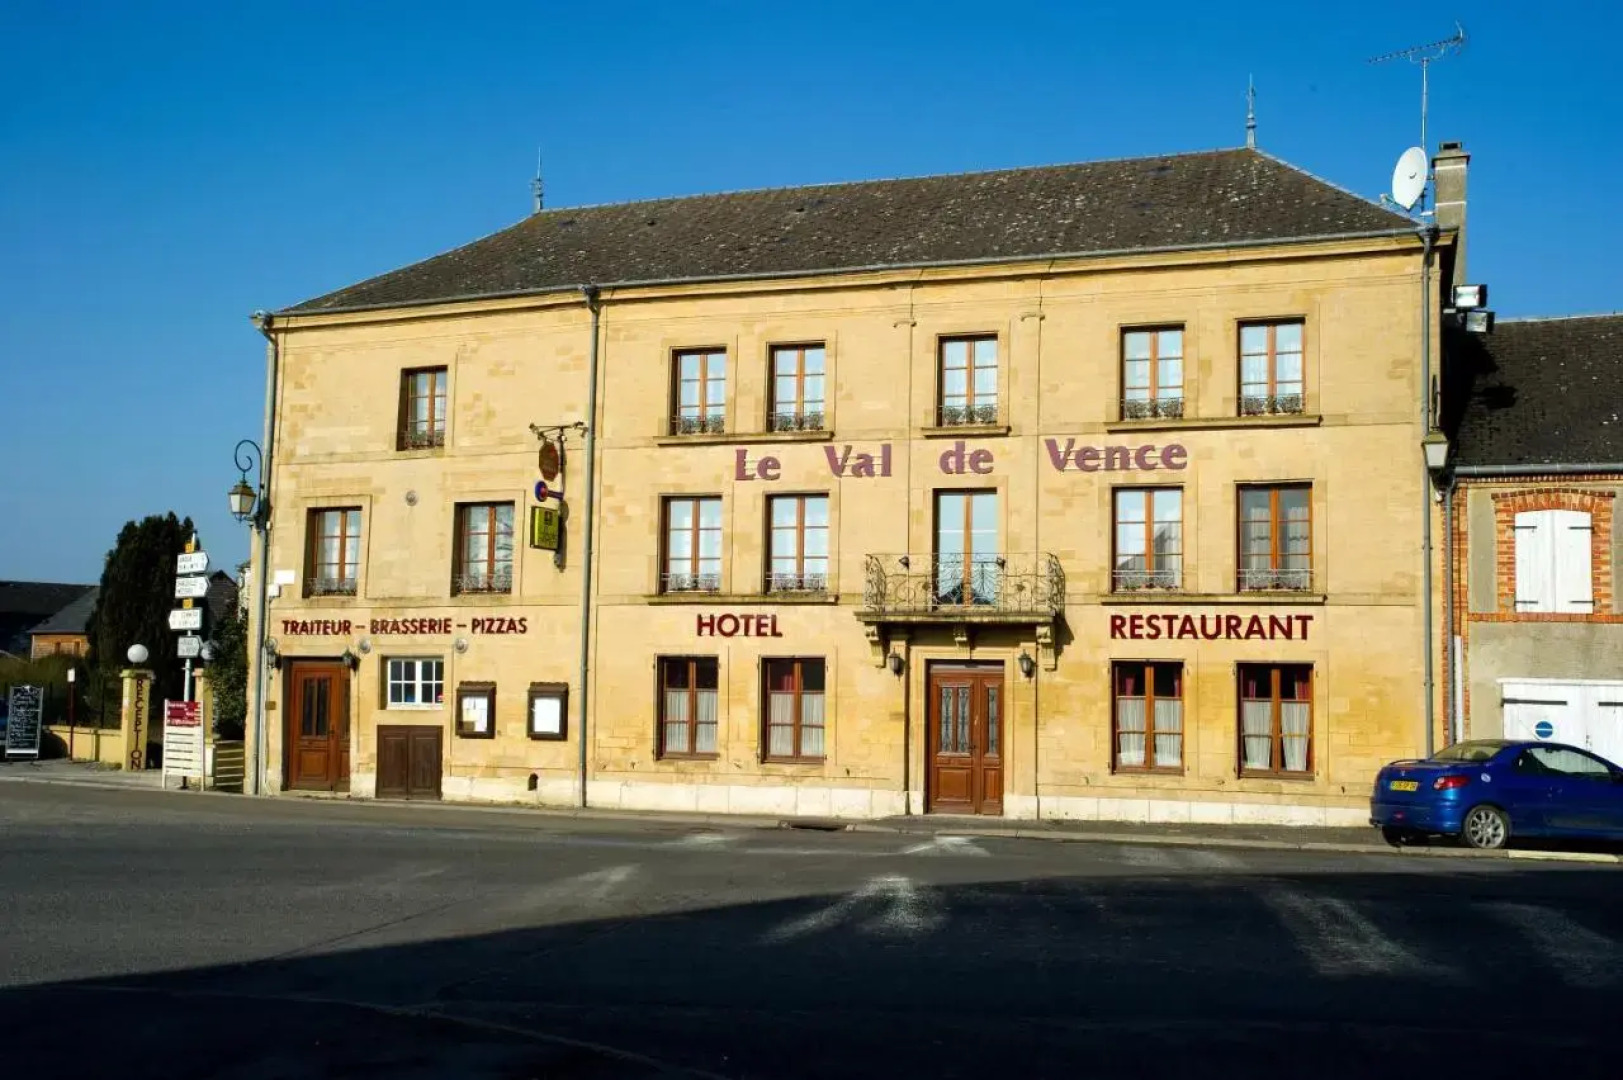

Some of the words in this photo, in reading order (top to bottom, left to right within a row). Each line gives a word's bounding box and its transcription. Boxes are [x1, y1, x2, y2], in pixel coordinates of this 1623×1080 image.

[735, 448, 782, 481] Le
[823, 443, 892, 478] Val
[939, 440, 994, 475] de
[1044, 438, 1188, 473] Vence
[282, 620, 351, 636] TRAITEUR
[370, 619, 452, 635] BRASSERIE
[471, 617, 528, 635] PIZZAS
[697, 613, 783, 638] HOTEL
[1110, 614, 1314, 640] RESTAURANT
[131, 679, 143, 770] RECEPTION
